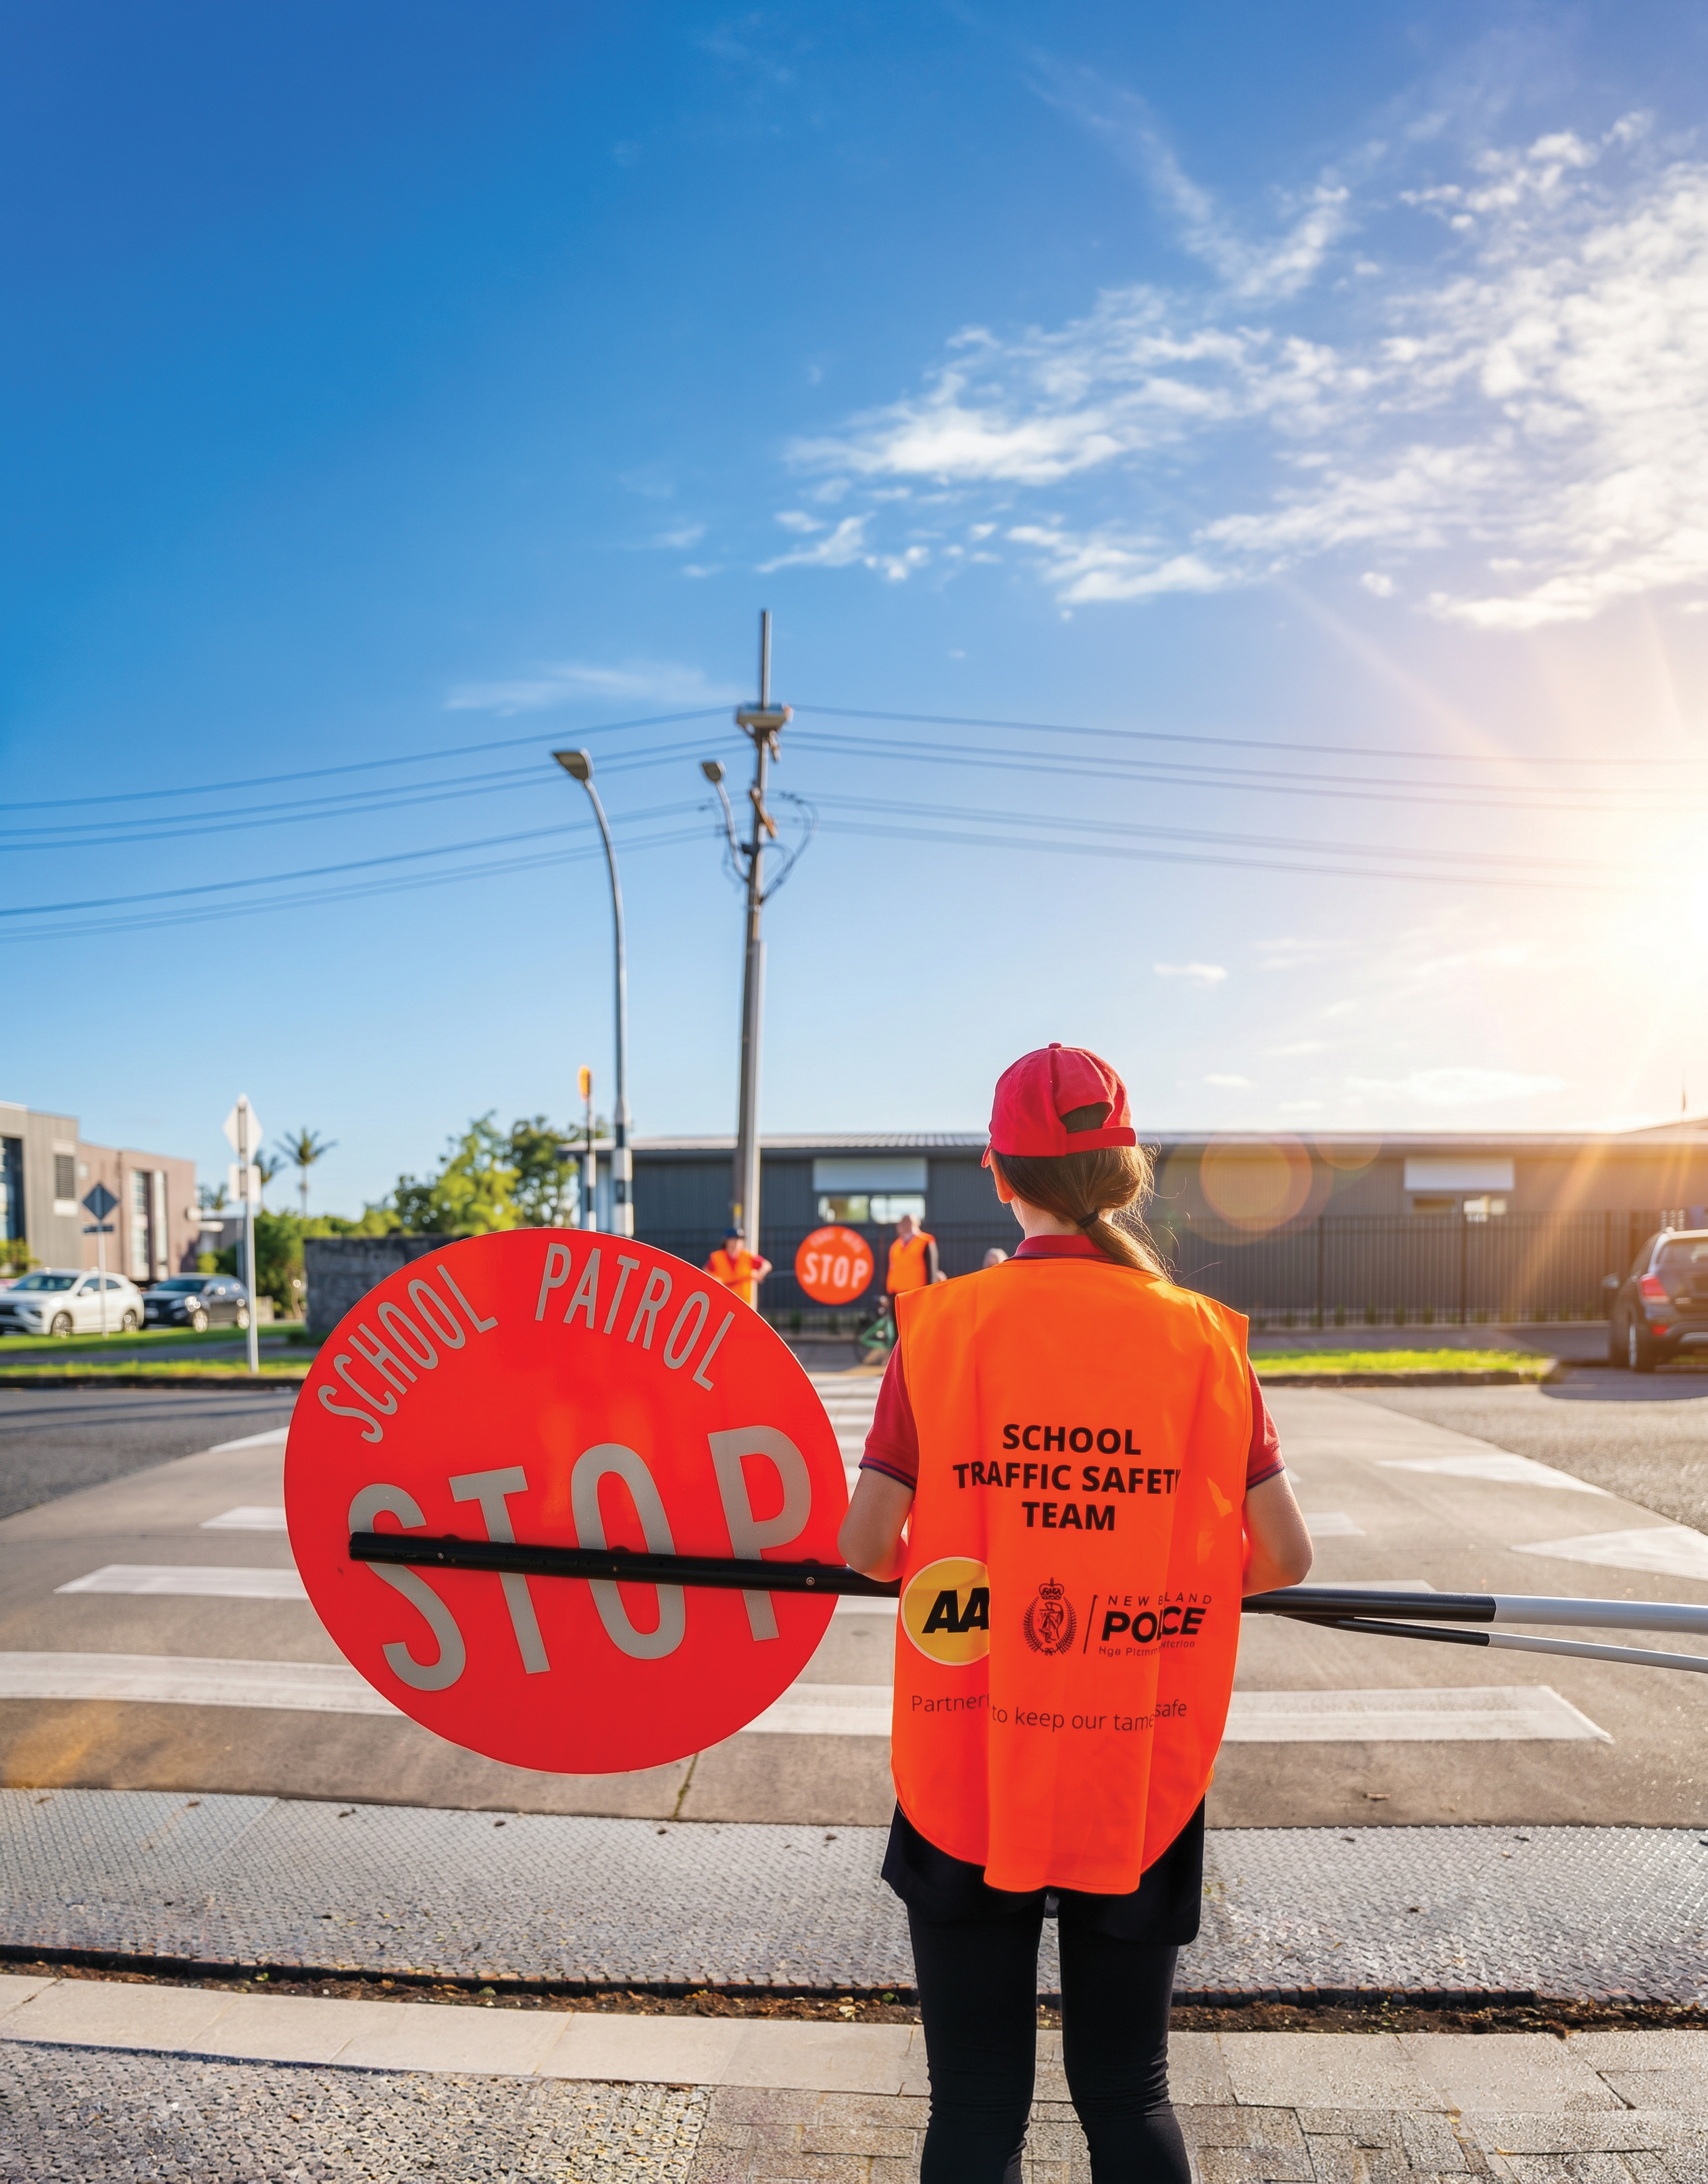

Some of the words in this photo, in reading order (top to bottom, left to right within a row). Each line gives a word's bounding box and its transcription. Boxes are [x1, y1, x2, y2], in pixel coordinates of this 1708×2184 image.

[802, 1251, 869, 1289] STOP
[317, 1264, 499, 1443] SCHOOL
[534, 1242, 735, 1391] PATROL
[1002, 1423, 1142, 1456] SCHOOL
[952, 1460, 1072, 1491] TRAFFIC
[1021, 1501, 1115, 1531] TEAM
[347, 1424, 812, 1691] STOP
[921, 1587, 990, 1634] AA
[1107, 1595, 1150, 1607] NEW
[991, 1705, 1008, 1723] to
[1015, 1706, 1065, 1733] keep
[1072, 1714, 1107, 1729] our
[1154, 1699, 1188, 1717] safe
